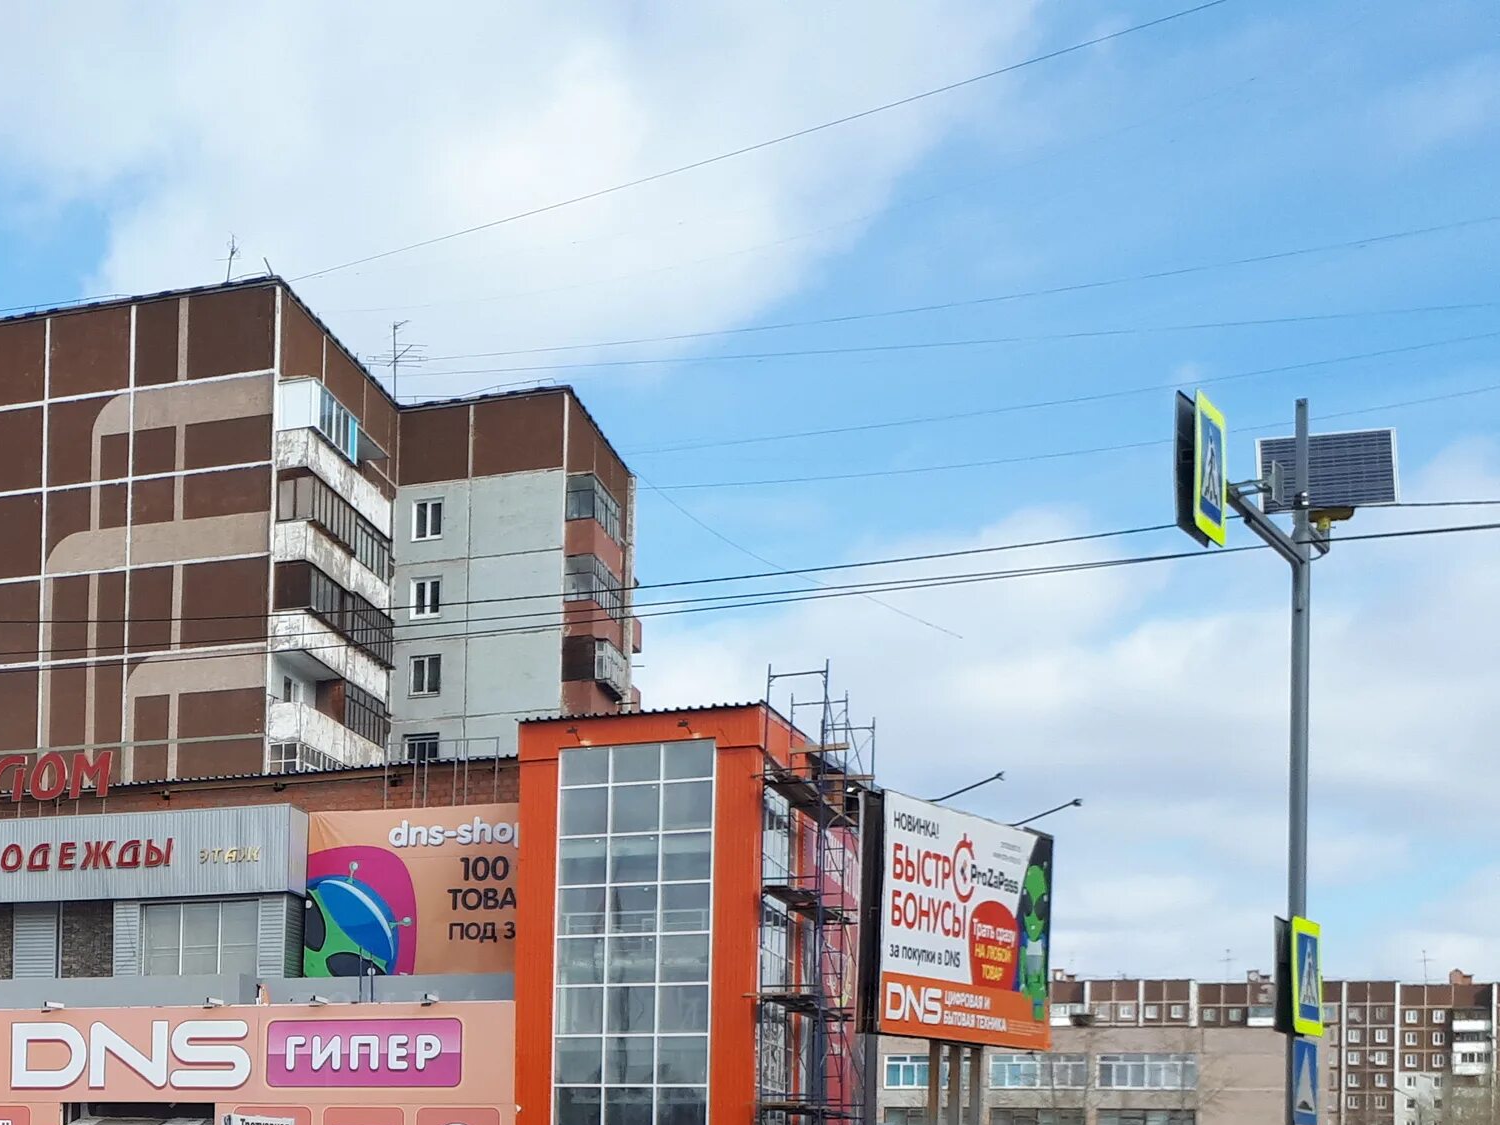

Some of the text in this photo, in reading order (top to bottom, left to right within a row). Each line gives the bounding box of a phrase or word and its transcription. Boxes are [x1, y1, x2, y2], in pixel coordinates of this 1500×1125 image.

[893, 811, 940, 839] НОВИНКА!
[0, 838, 261, 873] ОДЕЖДЫ ЭТАЖ
[460, 856, 510, 881] 100
[891, 889, 967, 940] БОНУСЫ
[448, 922, 497, 943] ПОД
[890, 944, 961, 968] за покупки в DNS
[885, 982, 943, 1025] DNS
[11, 1020, 252, 1087] DNS
[284, 1034, 443, 1071] ГИПЕР
